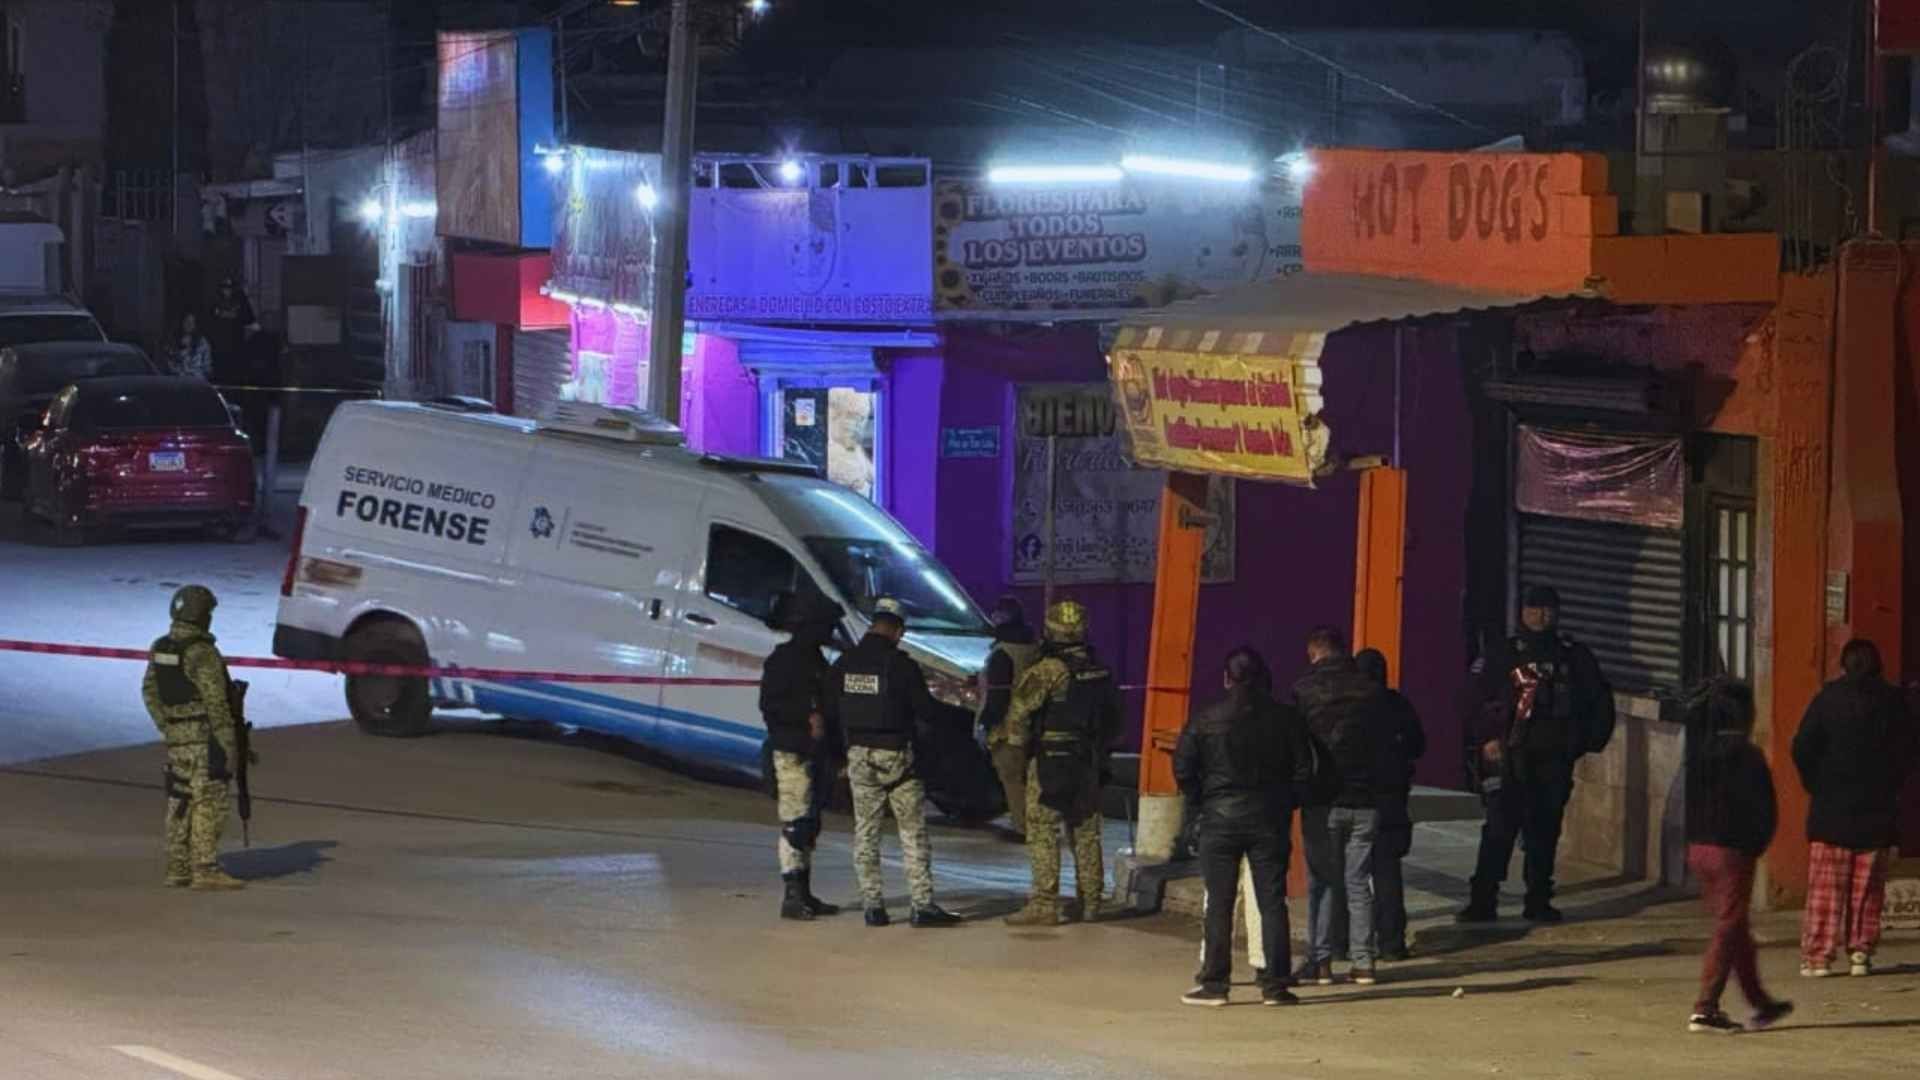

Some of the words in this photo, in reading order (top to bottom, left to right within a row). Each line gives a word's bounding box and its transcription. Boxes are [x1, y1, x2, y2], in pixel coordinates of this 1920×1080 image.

[967, 192, 1067, 216] FLORES
[1352, 162, 1428, 244] HOT
[1448, 160, 1549, 243] DOG'S
[1012, 213, 1101, 237] TODOS
[967, 240, 1019, 264] LOS
[1025, 235, 1144, 261] EVENTOS
[1030, 270, 1069, 283] BODAS
[1078, 270, 1145, 283] BAUTISMOS
[344, 466, 424, 495] SERVICIO
[427, 481, 496, 511] MEDICO
[337, 490, 490, 545] FORENSE
